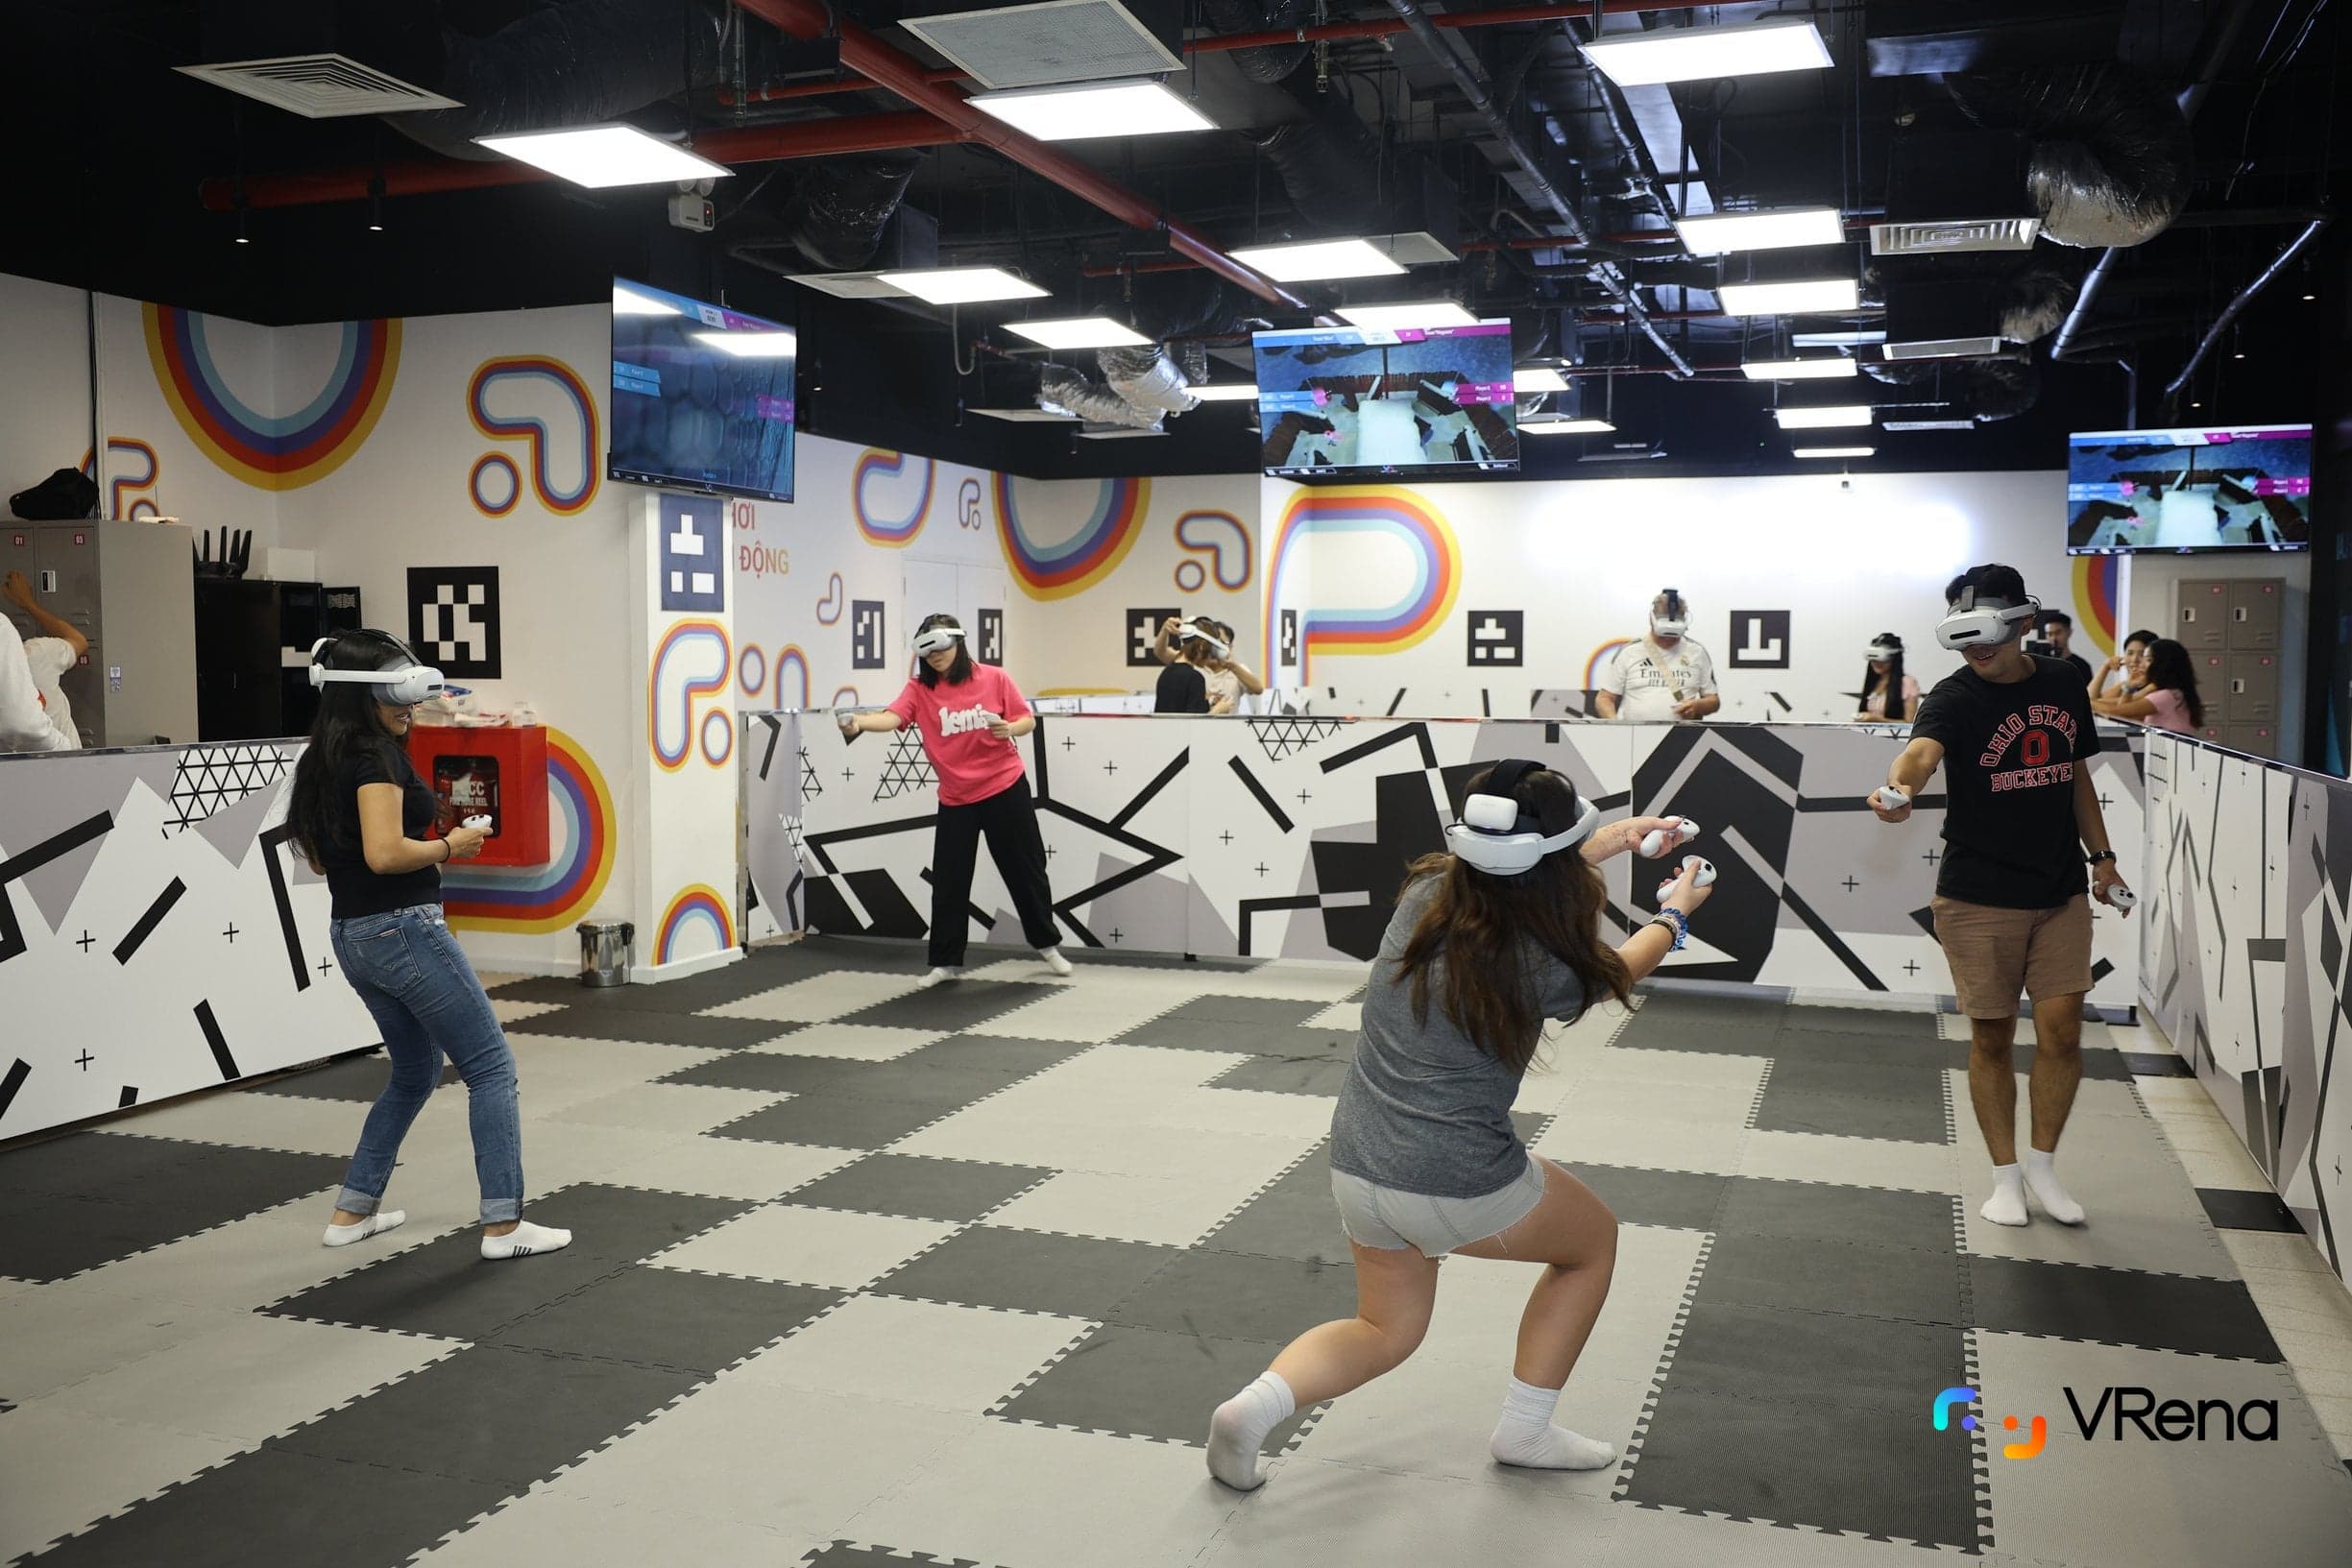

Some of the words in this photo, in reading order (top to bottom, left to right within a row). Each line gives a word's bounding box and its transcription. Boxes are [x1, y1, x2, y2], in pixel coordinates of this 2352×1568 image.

[739, 540, 789, 579] ĐỘNG
[1979, 712, 2025, 767] OHIO
[2028, 705, 2077, 753] STAT
